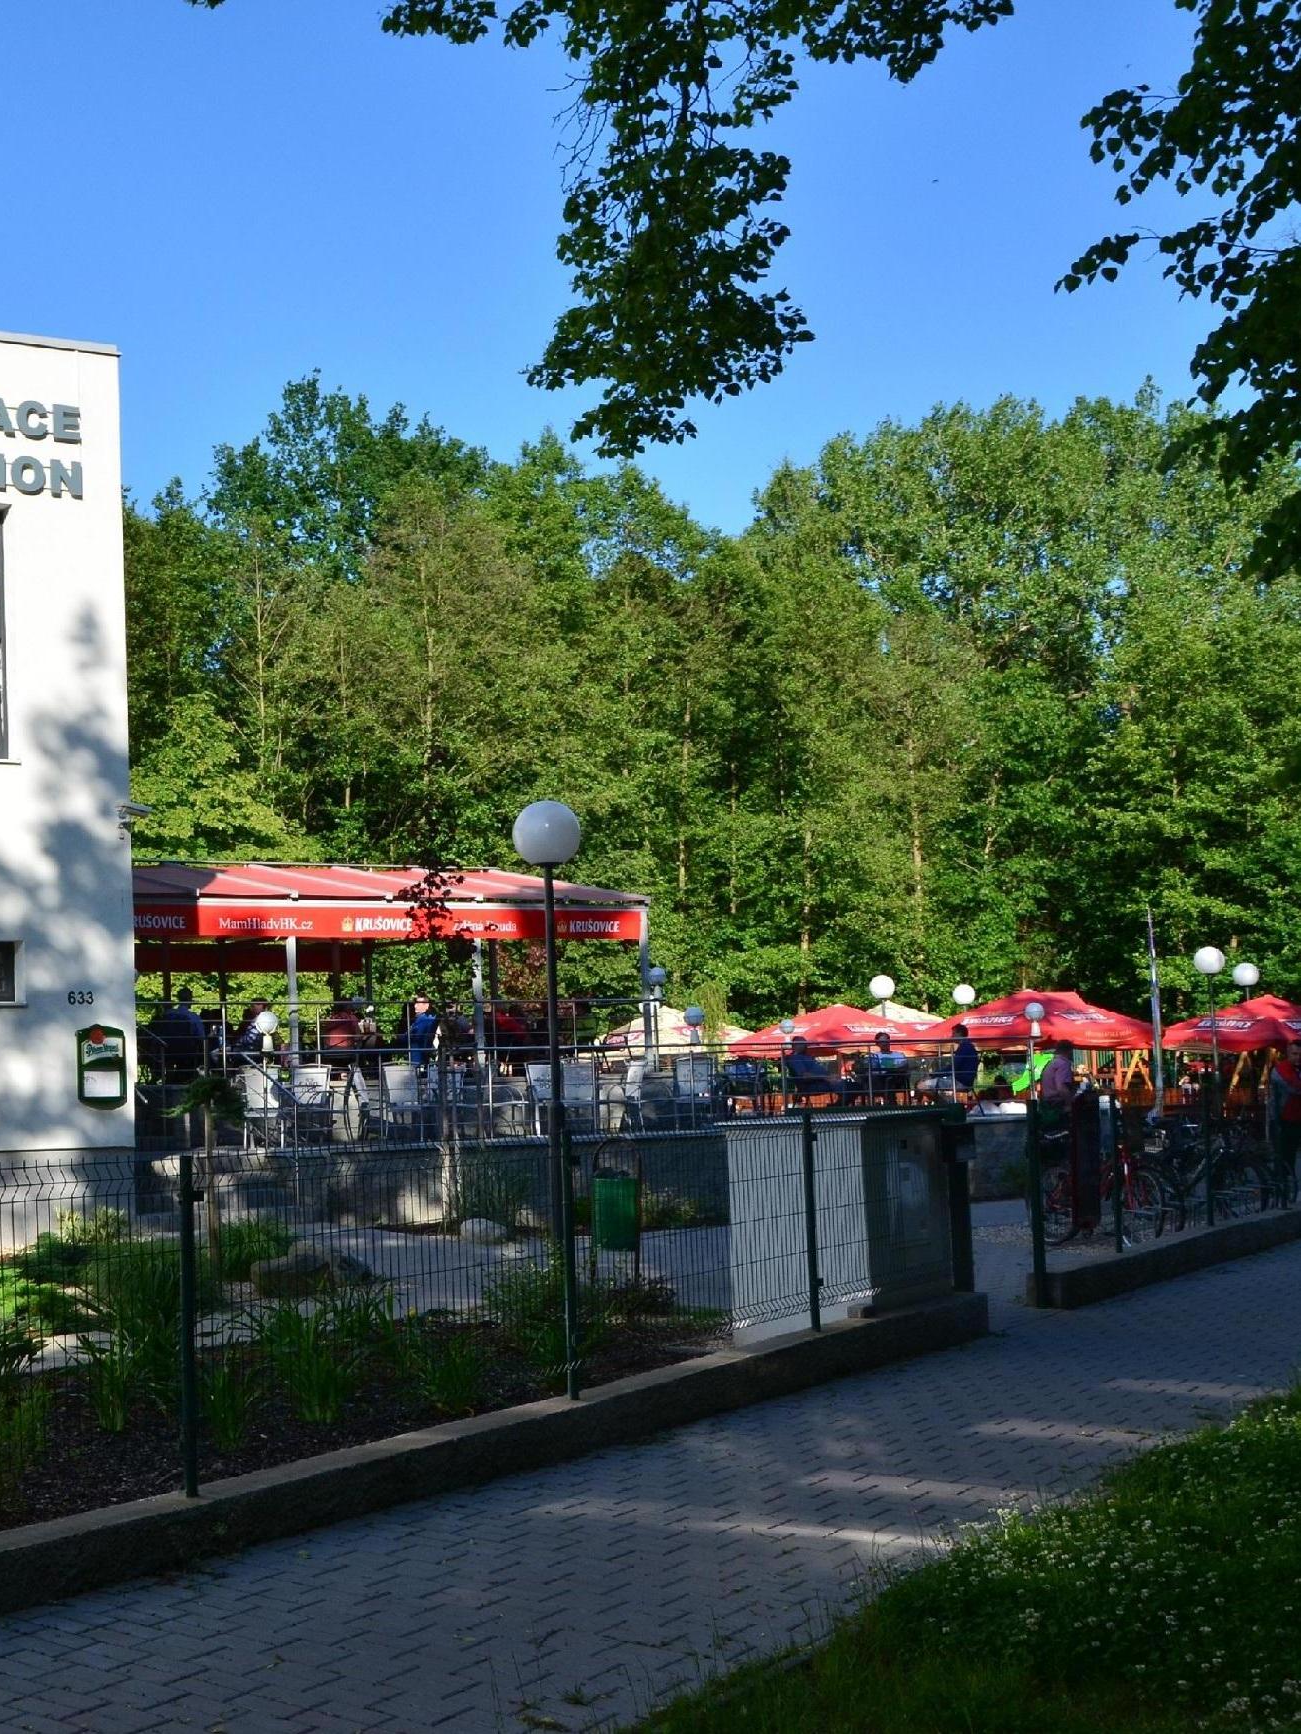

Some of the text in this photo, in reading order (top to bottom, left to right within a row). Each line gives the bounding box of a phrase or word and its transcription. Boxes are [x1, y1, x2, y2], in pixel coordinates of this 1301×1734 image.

[133, 912, 187, 929] RUŠOVICE
[354, 916, 413, 932] KRUŠOVICE
[570, 918, 620, 933] KRUŠOVICE
[67, 991, 95, 1005] 633
